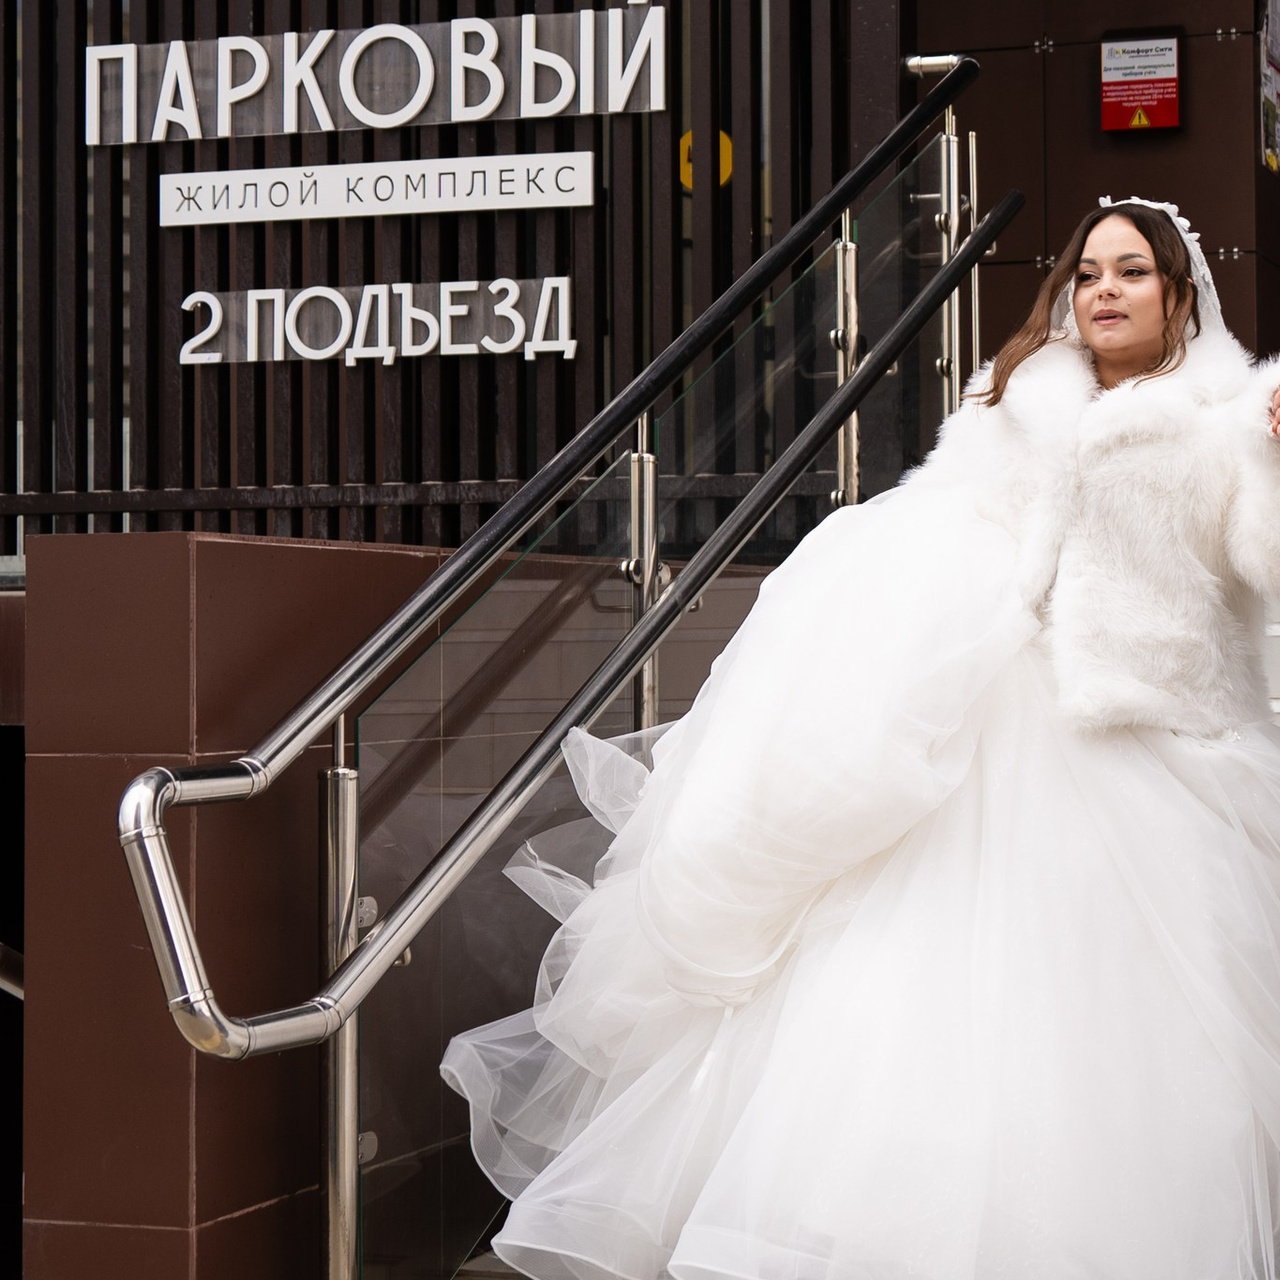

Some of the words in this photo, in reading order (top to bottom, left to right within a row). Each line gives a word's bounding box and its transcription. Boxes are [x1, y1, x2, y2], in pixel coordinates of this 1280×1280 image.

[175, 171, 319, 213] ЖИЛОЙ
[345, 165, 577, 204] КОМПЛЕКС
[179, 291, 223, 365] 2
[246, 277, 577, 367] ПОДЪЕЗД
